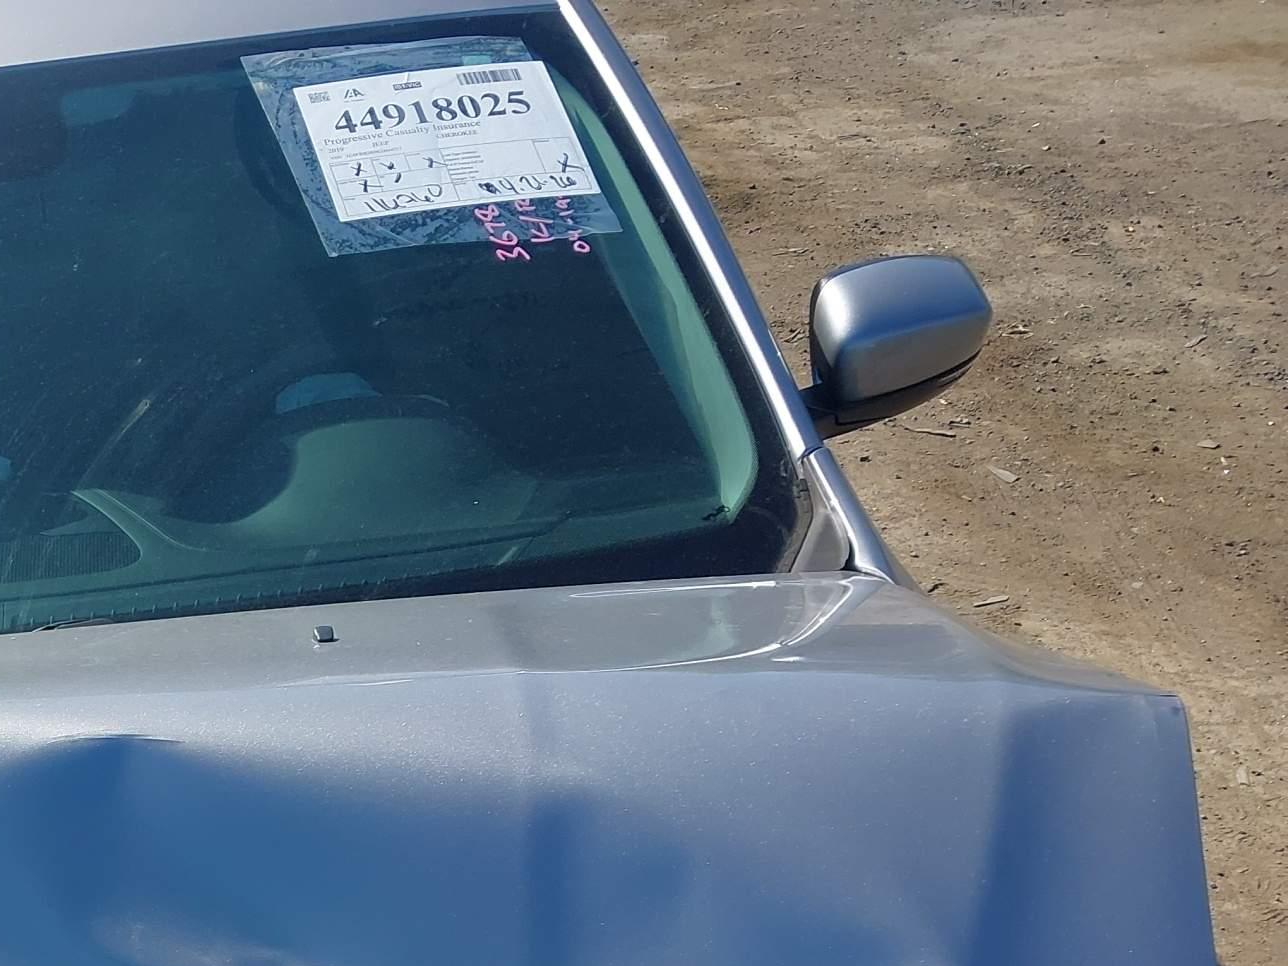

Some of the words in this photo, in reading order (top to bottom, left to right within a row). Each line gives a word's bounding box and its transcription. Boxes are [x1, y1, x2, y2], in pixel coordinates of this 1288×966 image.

[334, 90, 531, 133] 44918025
[324, 132, 383, 146] Progressive
[385, 126, 430, 137] Casualty
[432, 120, 481, 131] Insurance
